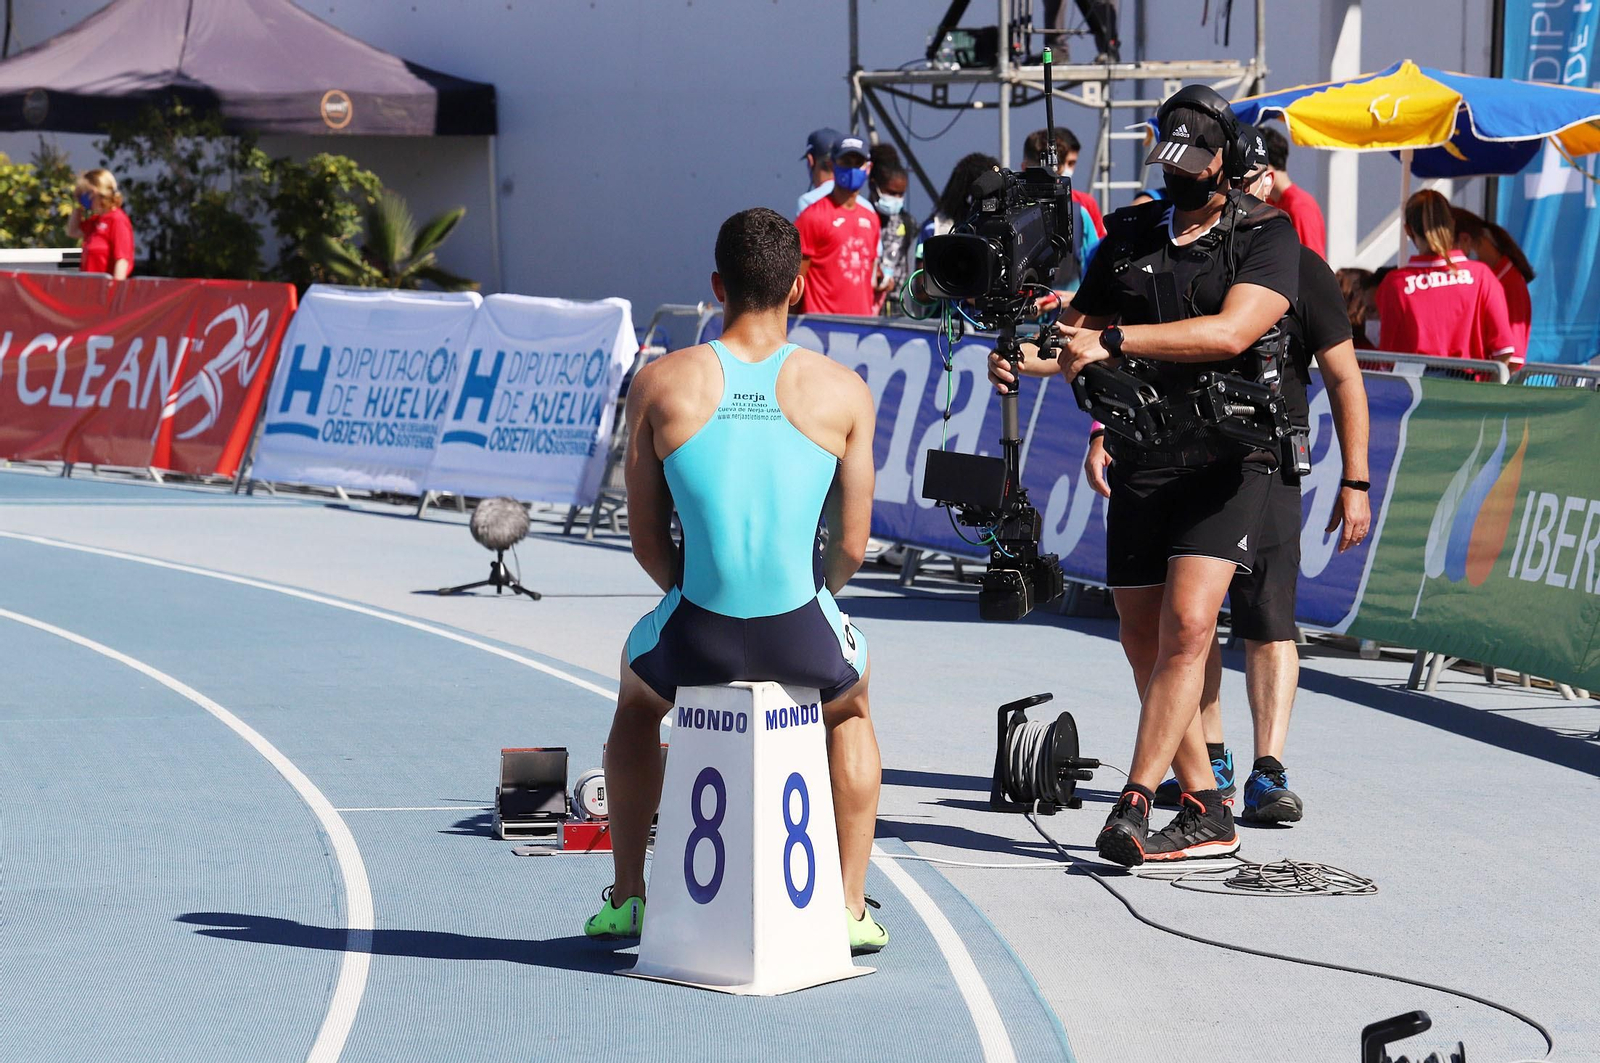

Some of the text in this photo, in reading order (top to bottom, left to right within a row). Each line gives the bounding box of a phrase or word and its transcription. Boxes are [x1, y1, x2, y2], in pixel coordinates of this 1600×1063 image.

[17, 332, 190, 410] CLEAN
[327, 384, 450, 421] DE HUELVA
[495, 390, 524, 424] DE
[733, 392, 766, 402] nerja
[677, 706, 748, 734] MONDO
[765, 702, 819, 731] MONDO
[684, 766, 727, 905] 8
[782, 771, 816, 909] 8
